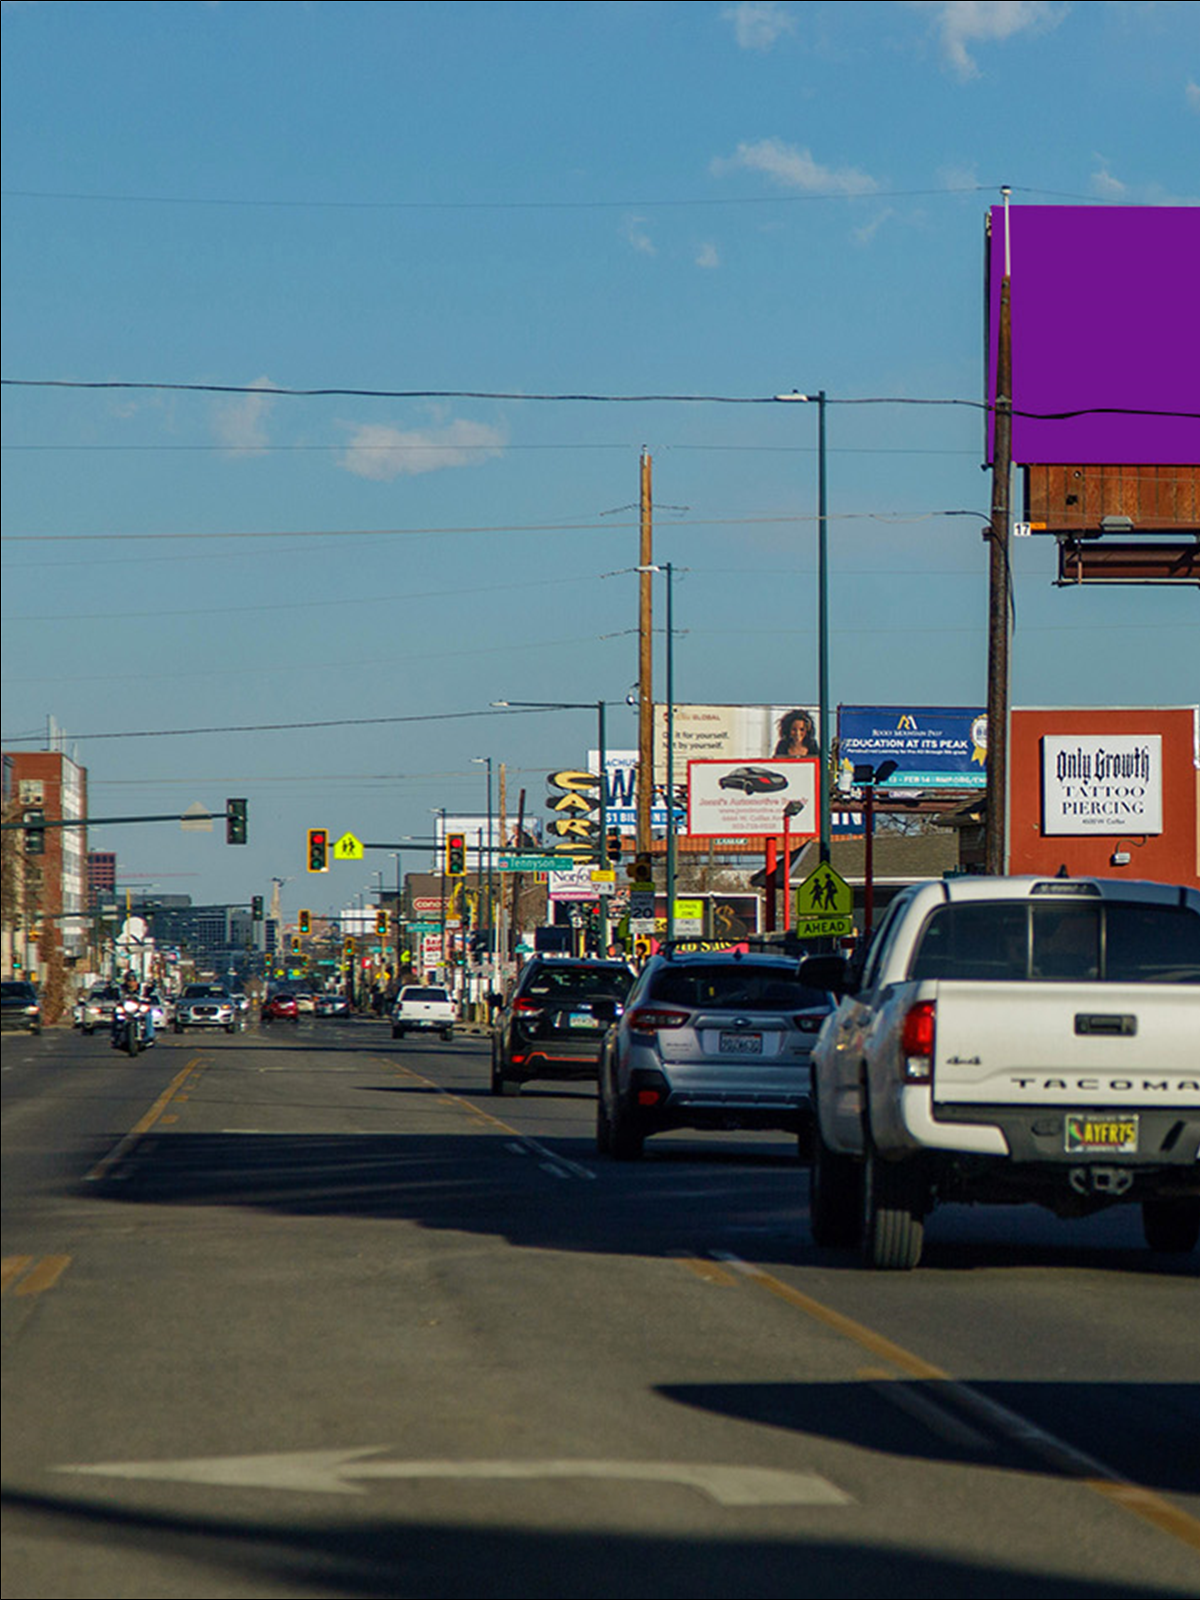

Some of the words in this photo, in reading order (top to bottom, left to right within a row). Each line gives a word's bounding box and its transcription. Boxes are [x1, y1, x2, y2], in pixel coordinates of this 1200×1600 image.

[1015, 523, 1030, 535] 17
[846, 738, 905, 748] EDUCATION
[906, 739, 919, 748] AT
[921, 740, 938, 748] ITS
[940, 740, 968, 749] PEAK
[1056, 747, 1092, 785] Only
[1094, 746, 1150, 785] Growth
[1062, 786, 1145, 797] TATTOO
[1062, 801, 1145, 815] PIERCING
[510, 858, 556, 870] Tennyson
[553, 866, 593, 886] Norfol
[632, 907, 653, 918] 20
[804, 921, 846, 934] AHEAD
[1011, 1078, 1200, 1092] TACOMA
